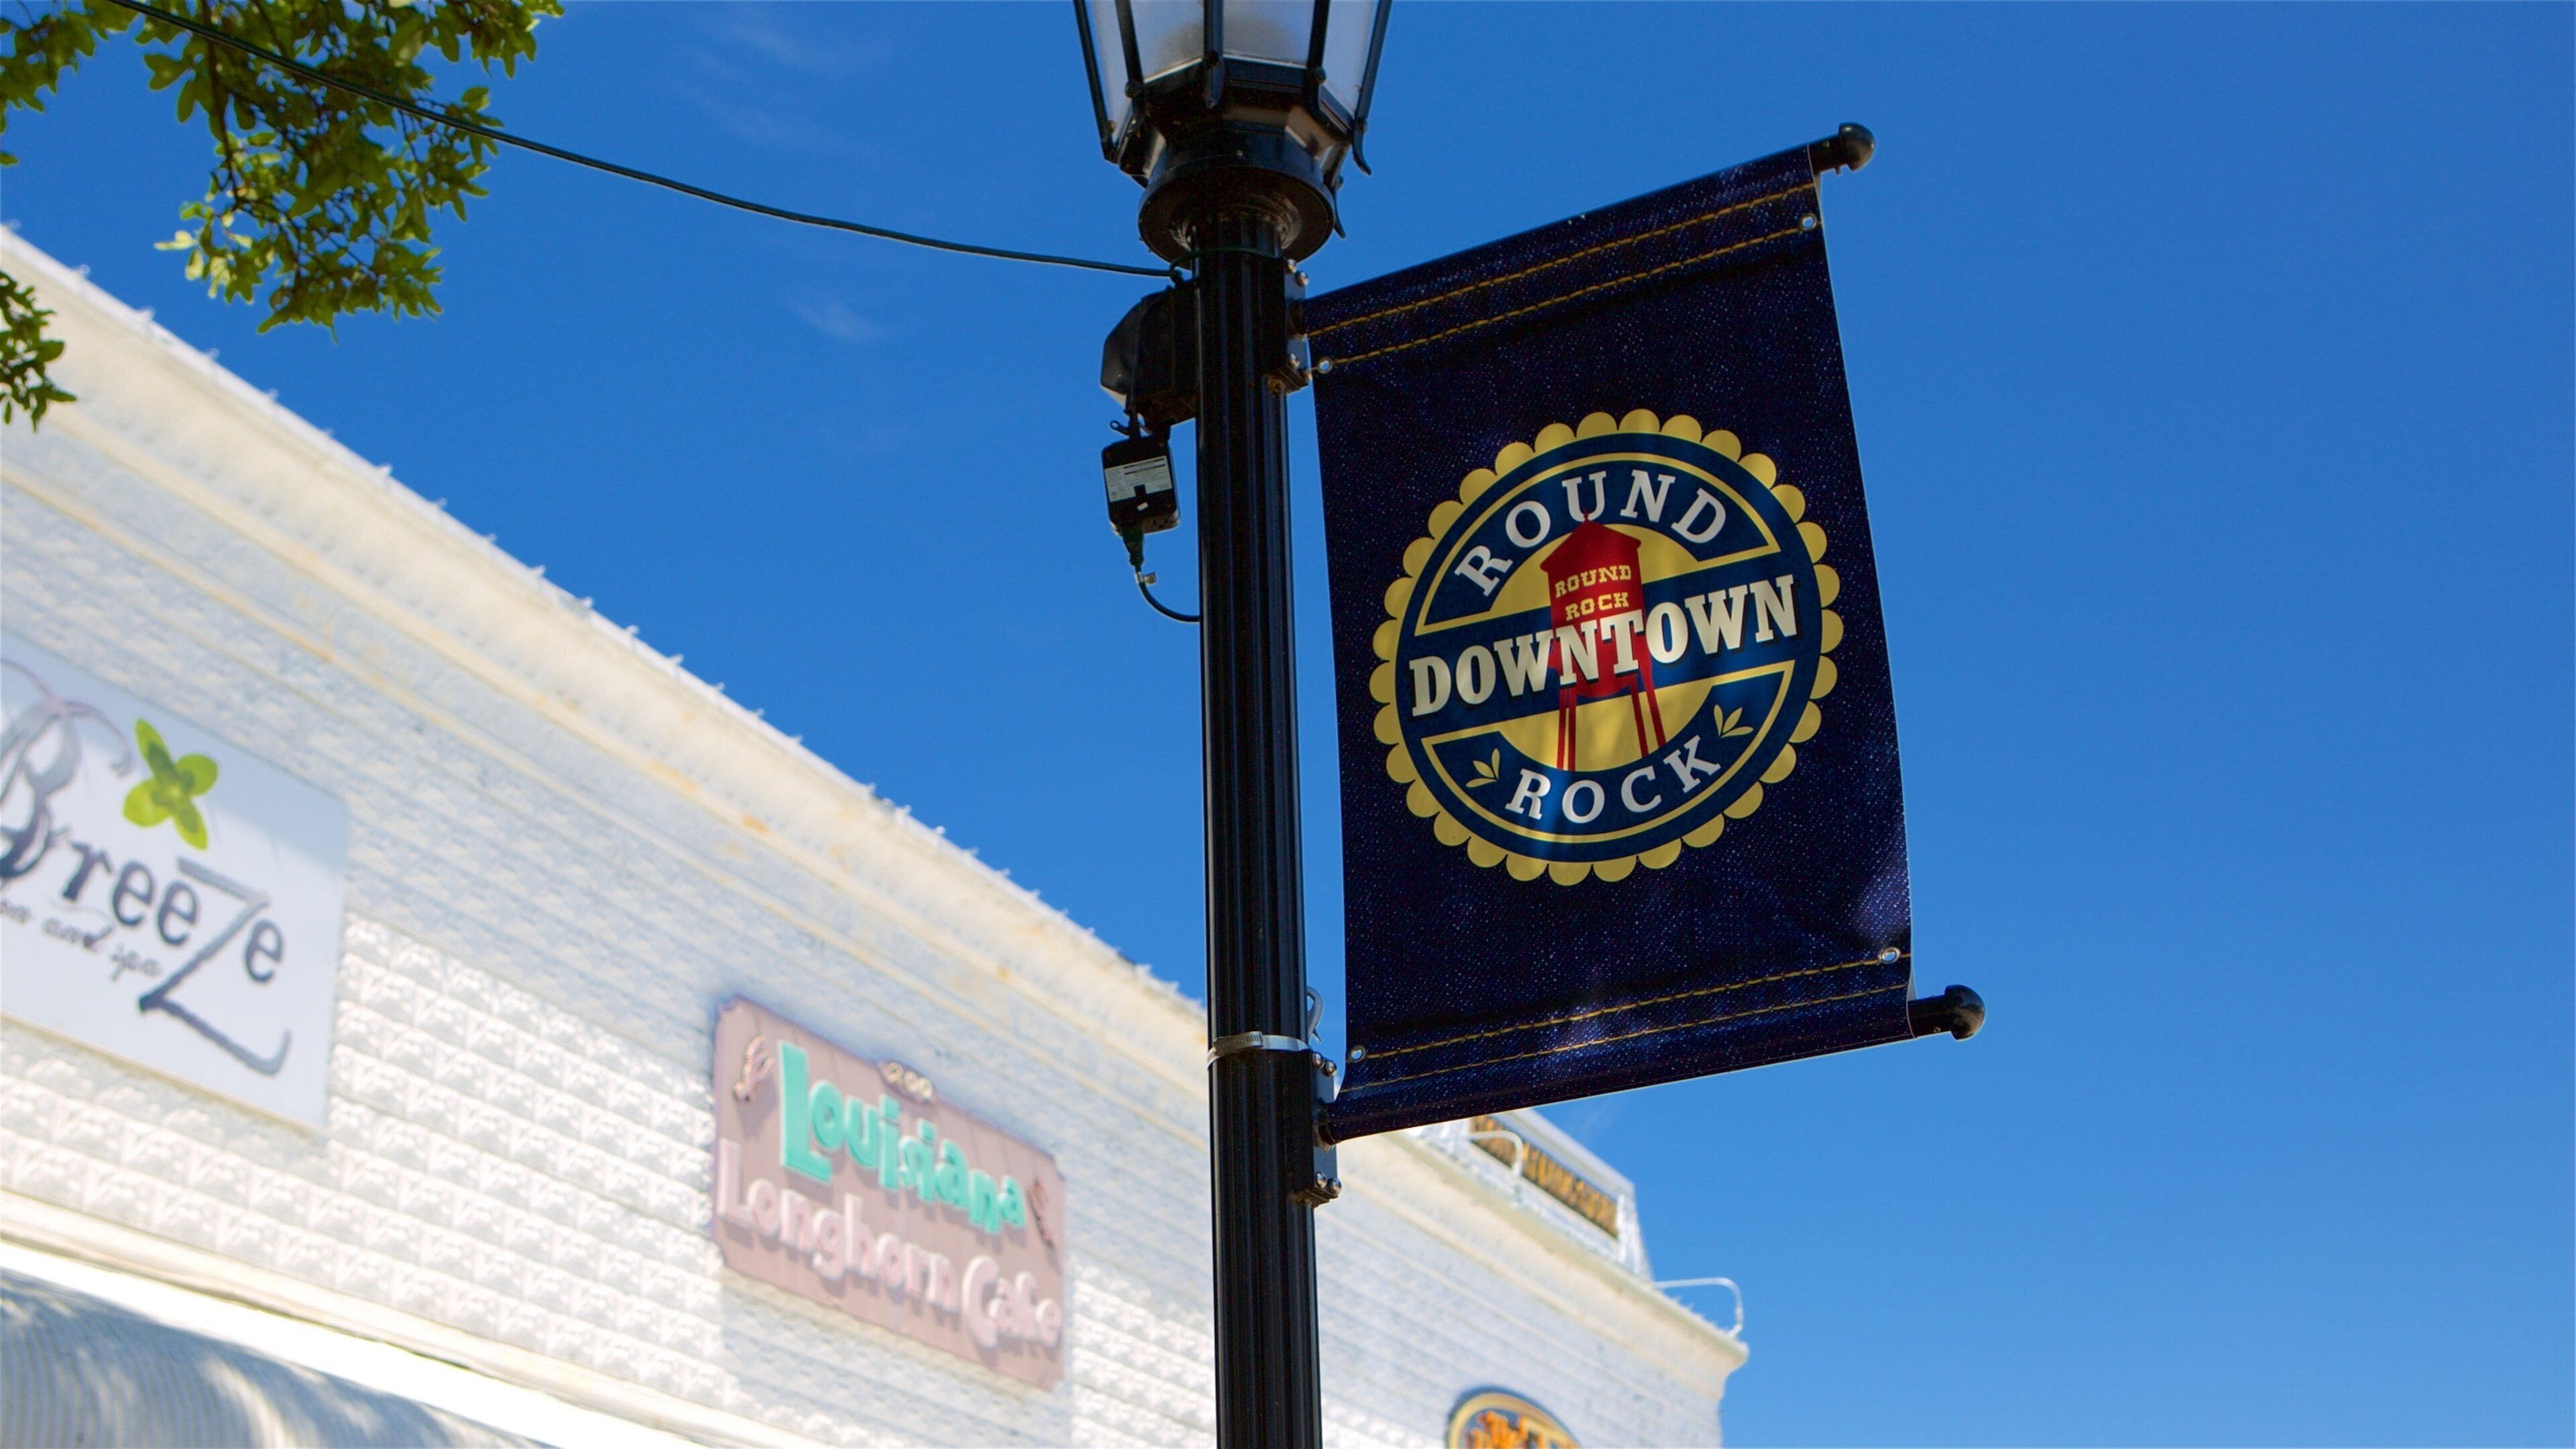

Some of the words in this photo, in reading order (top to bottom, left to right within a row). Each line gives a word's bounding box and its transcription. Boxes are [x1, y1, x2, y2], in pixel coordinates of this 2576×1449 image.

[1454, 470, 1727, 596] ROUND
[1554, 564, 1632, 598] ROUND
[1409, 574, 1800, 718] DOWNTOWN
[1564, 591, 1630, 621] ROCK
[1505, 735, 1721, 824] ROCK
[777, 1040, 1027, 1235] Louisiana
[716, 1137, 960, 1314] Longhorn
[963, 1254, 1063, 1349] Cafe
